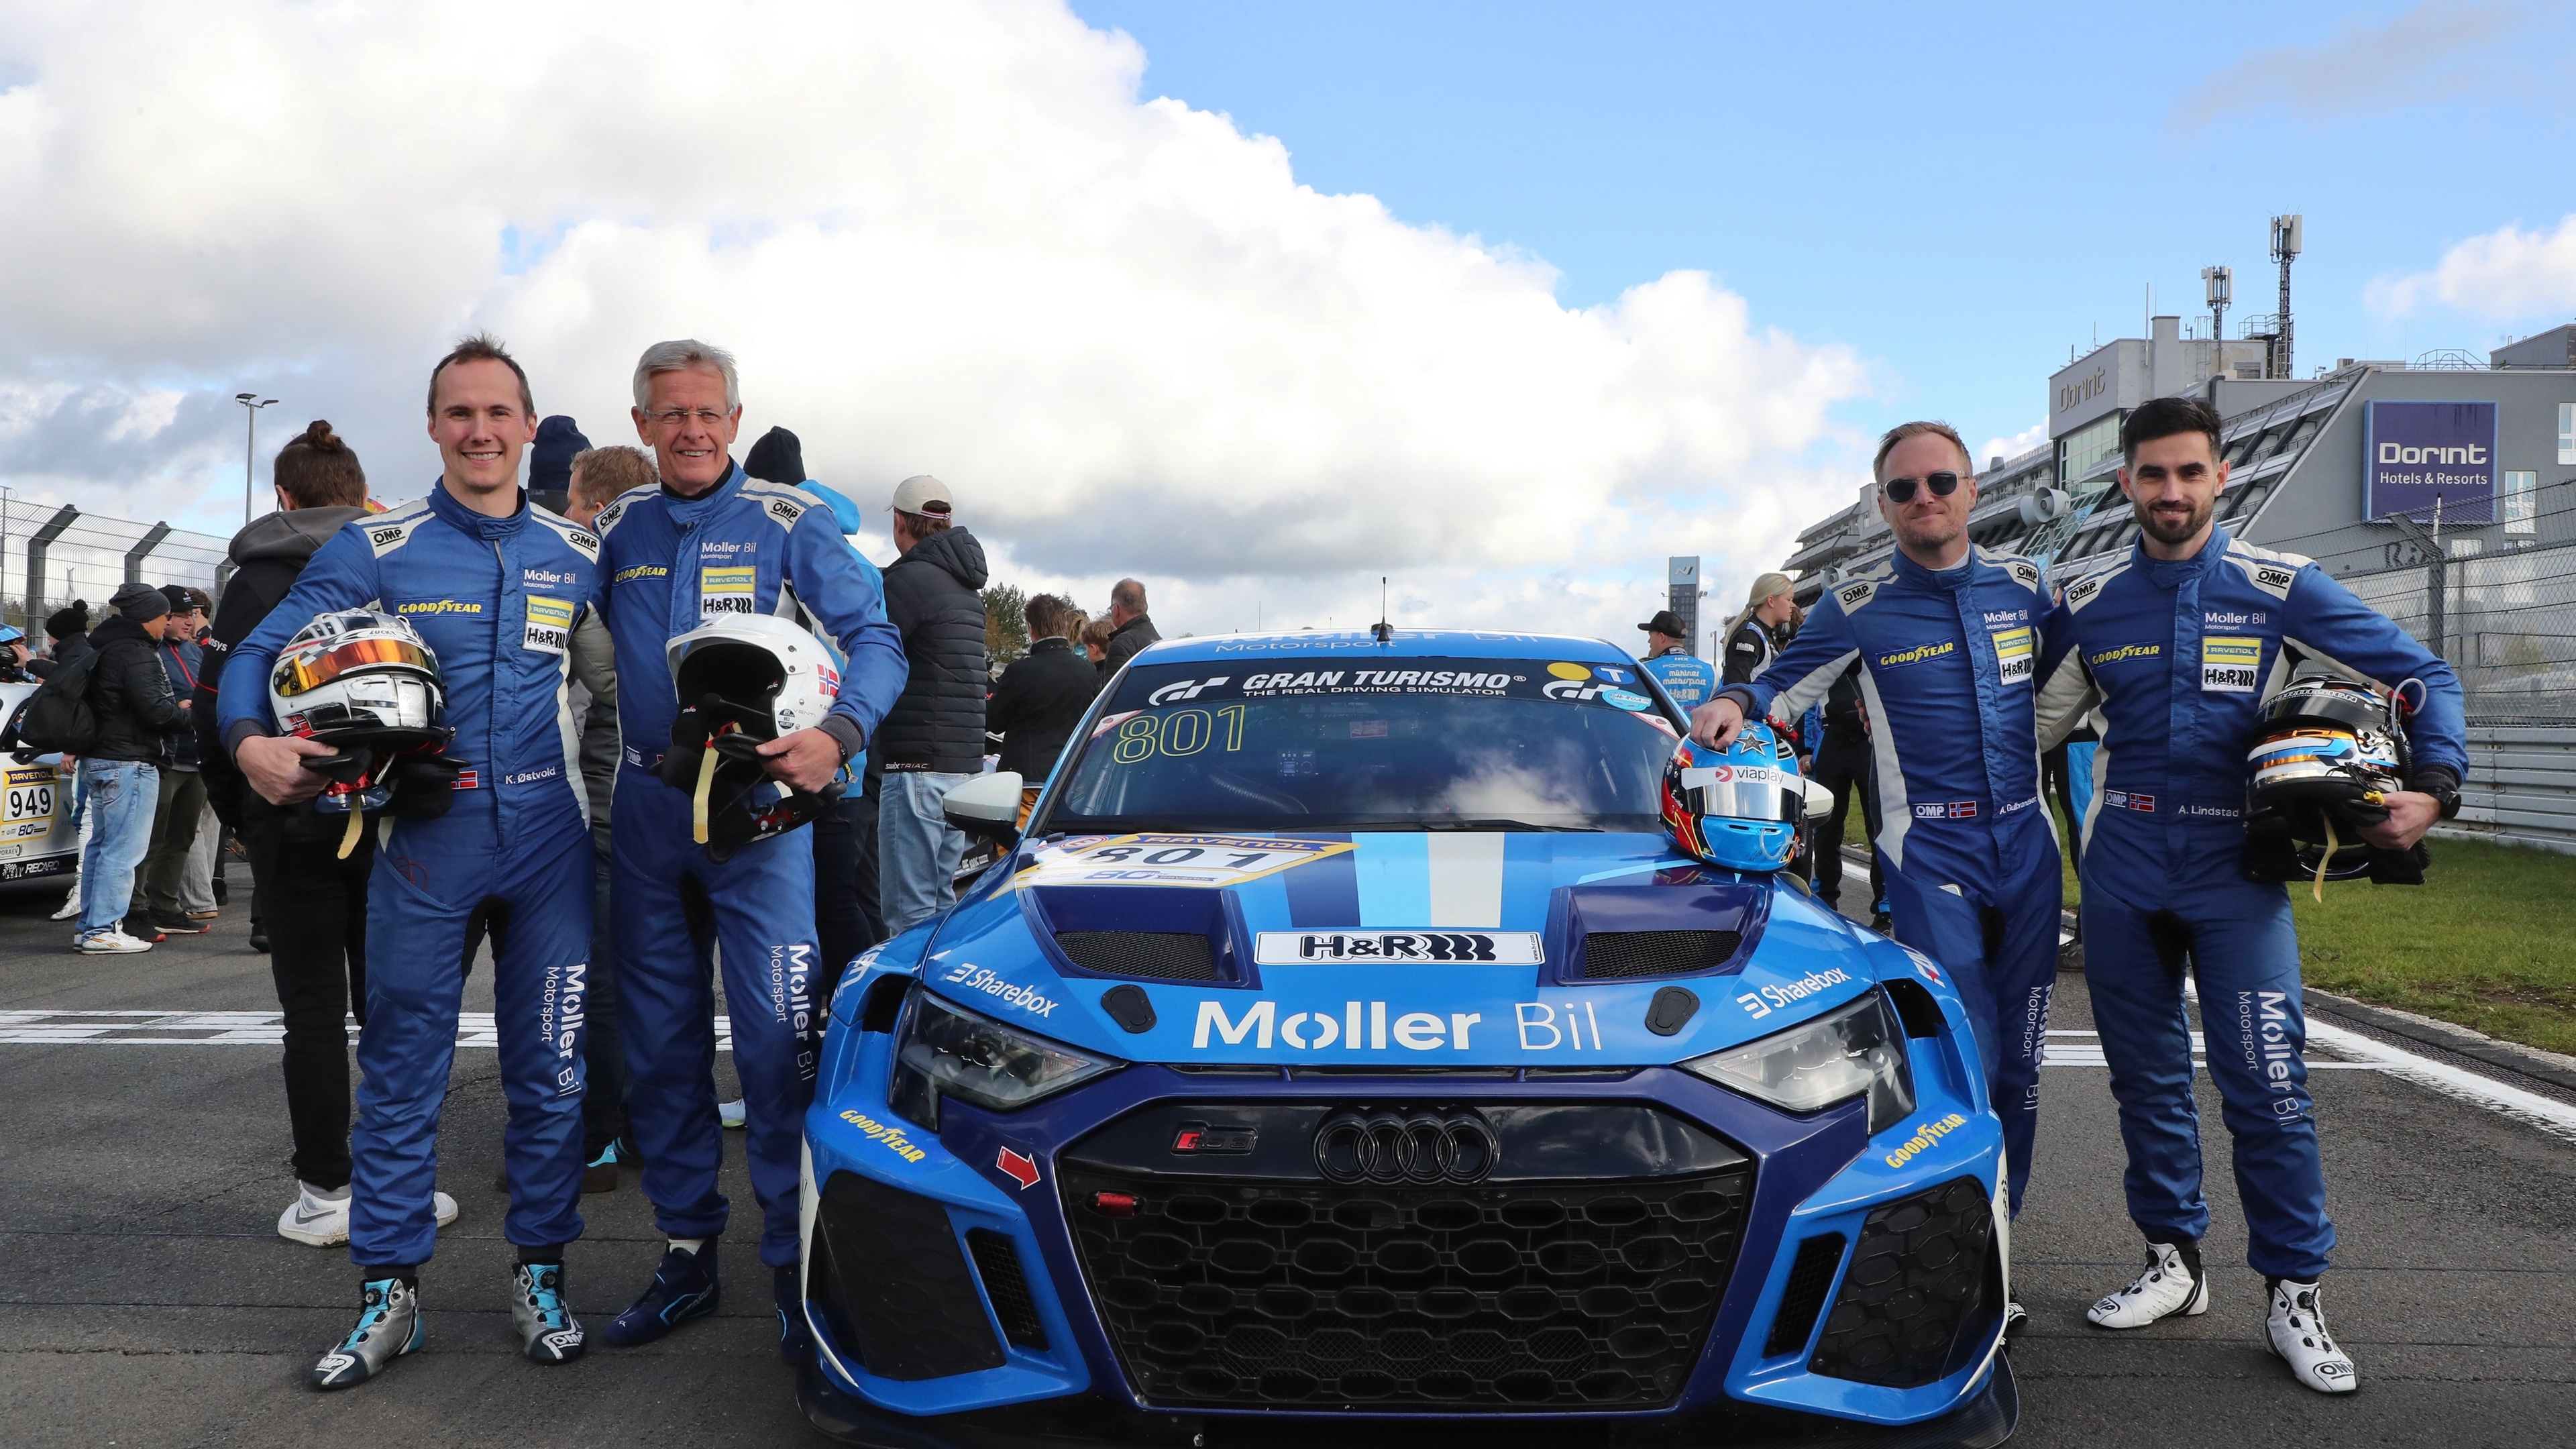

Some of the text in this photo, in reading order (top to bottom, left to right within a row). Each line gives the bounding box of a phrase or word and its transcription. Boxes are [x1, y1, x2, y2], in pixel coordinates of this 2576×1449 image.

[2060, 366, 2105, 413] Dorint
[2379, 443, 2487, 464] Dorint
[2380, 472, 2487, 485] Hotels & Resorts
[599, 505, 621, 526] OMP
[773, 502, 798, 519] OMP
[374, 529, 402, 544] OMP
[570, 534, 598, 549] OMP
[743, 542, 757, 553] Bil
[564, 572, 576, 584] Bil
[616, 566, 667, 582] GOODYEAR
[2017, 566, 2037, 581] OMP
[2258, 571, 2290, 585] OMP
[523, 582, 555, 590] Motorsport
[1843, 584, 1870, 602] OMP
[2070, 582, 2096, 600] OMP
[398, 600, 482, 615] GOODYEAR
[533, 606, 568, 618] RAVENOL
[703, 598, 734, 614] H&R
[2019, 609, 2029, 621] Bil
[2252, 612, 2265, 624] Bil
[527, 627, 556, 647] H&R
[2000, 637, 2029, 648] RAVENOL
[1215, 640, 1397, 653] Motorsport
[1880, 642, 1954, 666] GOODYEAR
[2092, 645, 2159, 664] GOODYEAR
[2211, 647, 2254, 655] RAVENOL
[2002, 660, 2025, 678] H&R
[2204, 669, 2237, 686] H&R
[1242, 671, 1510, 690] GRAN TURISMO
[1662, 678, 1707, 686] motorsport
[1244, 689, 1279, 697] THE
[1414, 686, 1506, 696] SIMULATOR
[792, 708, 816, 718] VENTI
[1113, 704, 1246, 764] 801
[11, 771, 52, 782] RAVENOL
[505, 767, 555, 784] K. Østvold
[1736, 767, 1784, 785] viaplay
[10, 788, 51, 818] 949
[2106, 792, 2127, 805] OMP
[1915, 806, 1945, 816] OMP
[2178, 805, 2239, 817] A. Lindstad
[1144, 837, 1314, 851] RAVENOL
[1077, 847, 1270, 869] 801
[25, 861, 60, 874] RECARO
[1300, 934, 1426, 960] H&R
[1529, 934, 1540, 961] www.h-r.com
[771, 945, 788, 1023] Motorsport
[1760, 967, 1852, 1008] Sharebox
[966, 968, 1059, 1018] Sharebox
[539, 967, 561, 1042] Motorsport
[1514, 1002, 1602, 1051] Bil
[2022, 987, 2042, 1059] Motorsport
[2237, 991, 2259, 1071] Motorsport
[797, 1051, 816, 1081] Bil
[558, 1066, 582, 1097] Bil
[2273, 1097, 2303, 1126] Bil
[839, 1109, 926, 1164] GOODYEAR
[1885, 1113, 1967, 1169] GOODYEAR
